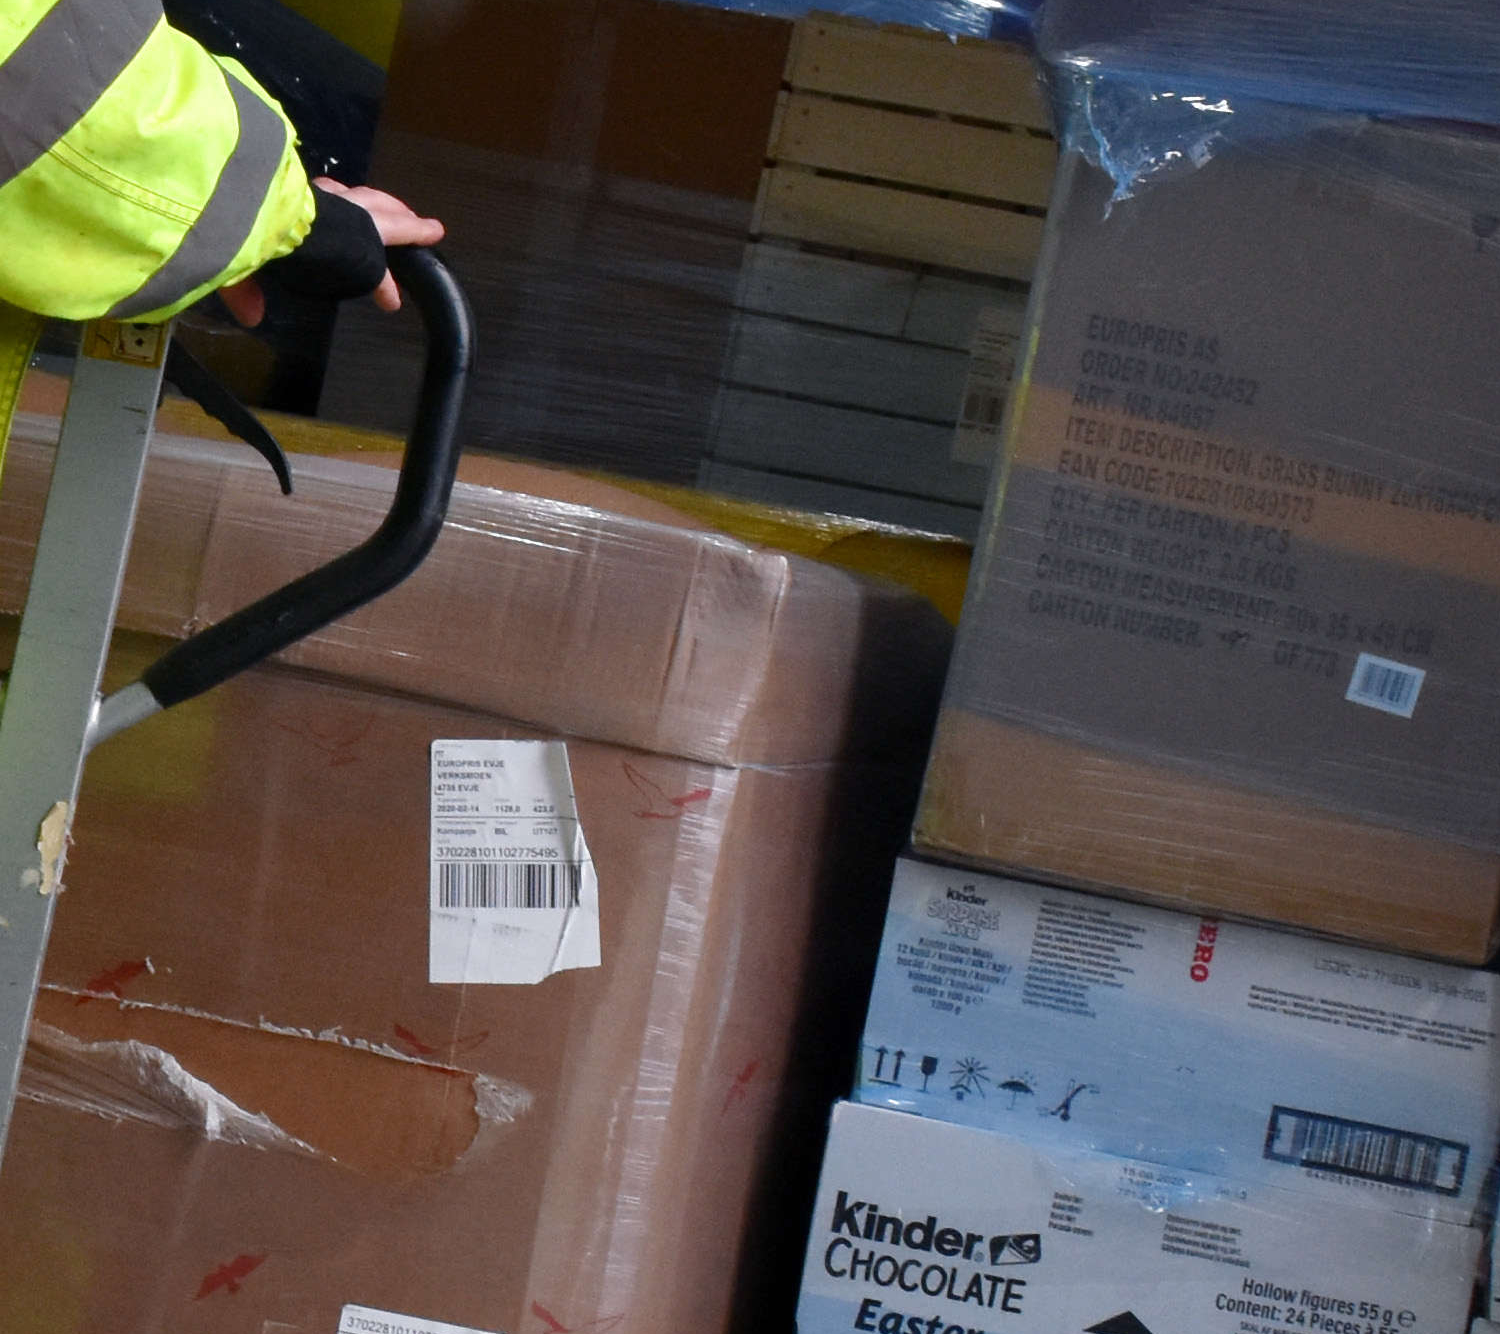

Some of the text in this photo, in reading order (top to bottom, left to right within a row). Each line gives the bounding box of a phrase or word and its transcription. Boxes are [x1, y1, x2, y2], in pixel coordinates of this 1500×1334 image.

[1084, 313, 1188, 357] EUROPRIS
[1064, 416, 1116, 449] ITEM
[1057, 448, 1099, 481] EAN
[436, 758, 505, 769] EUROPRIS EVJE
[436, 771, 493, 781] VERKSMOEN
[457, 783, 480, 793] EVJE
[436, 805, 480, 814] 2020-02-14
[435, 846, 560, 859] 370228101102775495
[823, 1237, 1028, 1315] CHOCOLATE
[1215, 1292, 1282, 1322] Content:
[1284, 1308, 1306, 1326] 24
[1242, 1277, 1394, 1327] Hollow figures 55 g
